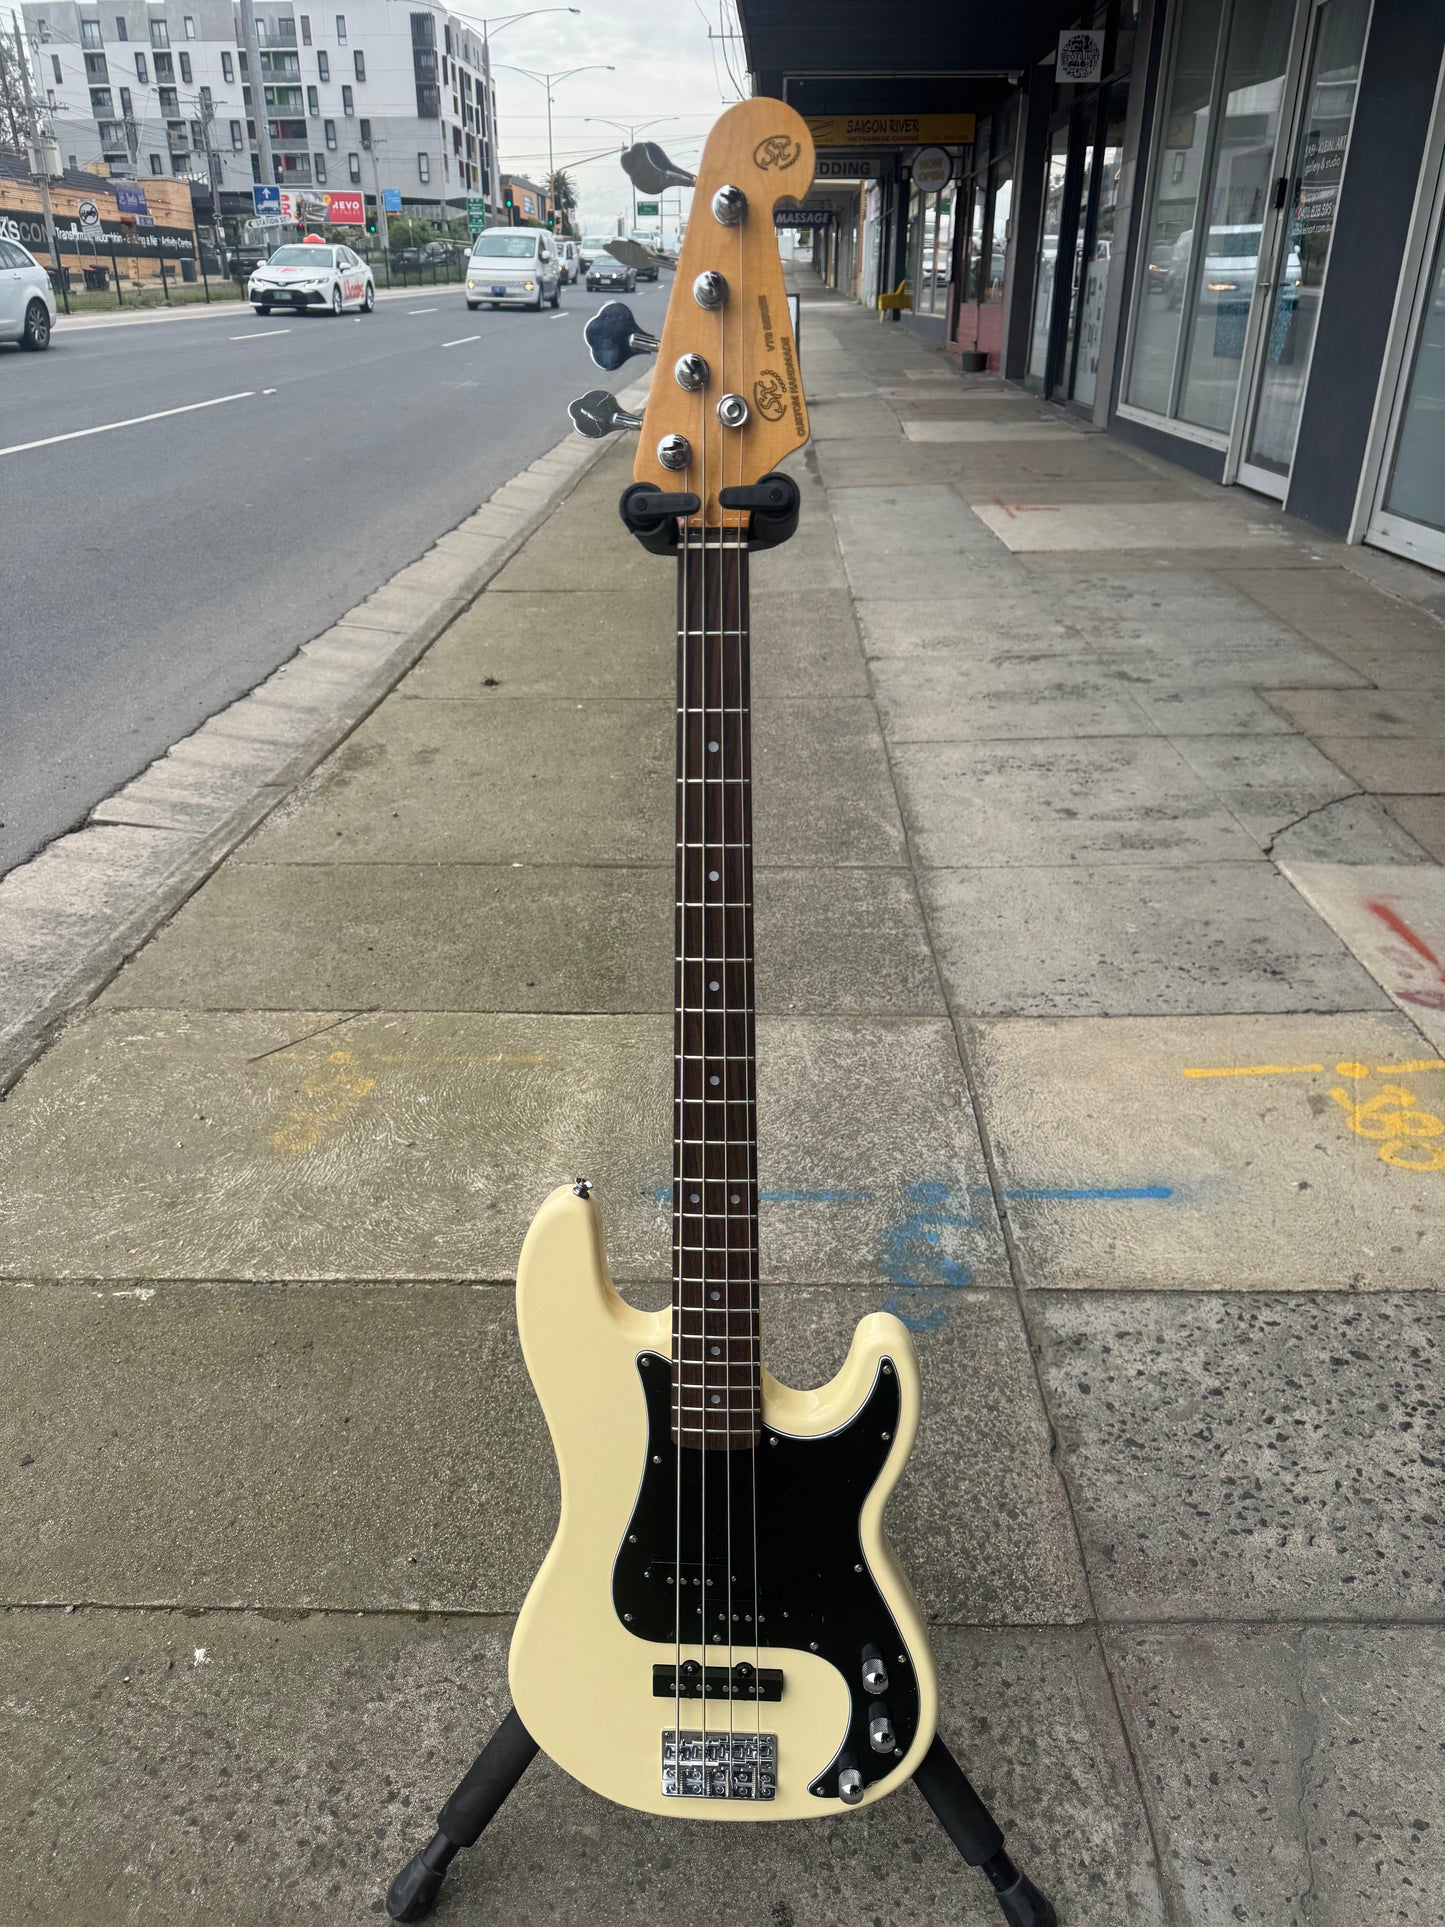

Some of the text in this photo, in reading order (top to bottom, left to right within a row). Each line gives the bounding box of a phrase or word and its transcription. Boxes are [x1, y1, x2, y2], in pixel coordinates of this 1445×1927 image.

[846, 118, 920, 133] SAIGON RIVER
[815, 161, 871, 175] DDING
[919, 157, 943, 170] NOW
[919, 170, 945, 182] OPEN
[332, 200, 360, 209] REVO
[256, 217, 279, 226] STATION
[775, 212, 831, 223] MASSAGE
[95, 231, 123, 243] Moorbbin
[780, 336, 806, 437] CUSTOM HANDMADE
